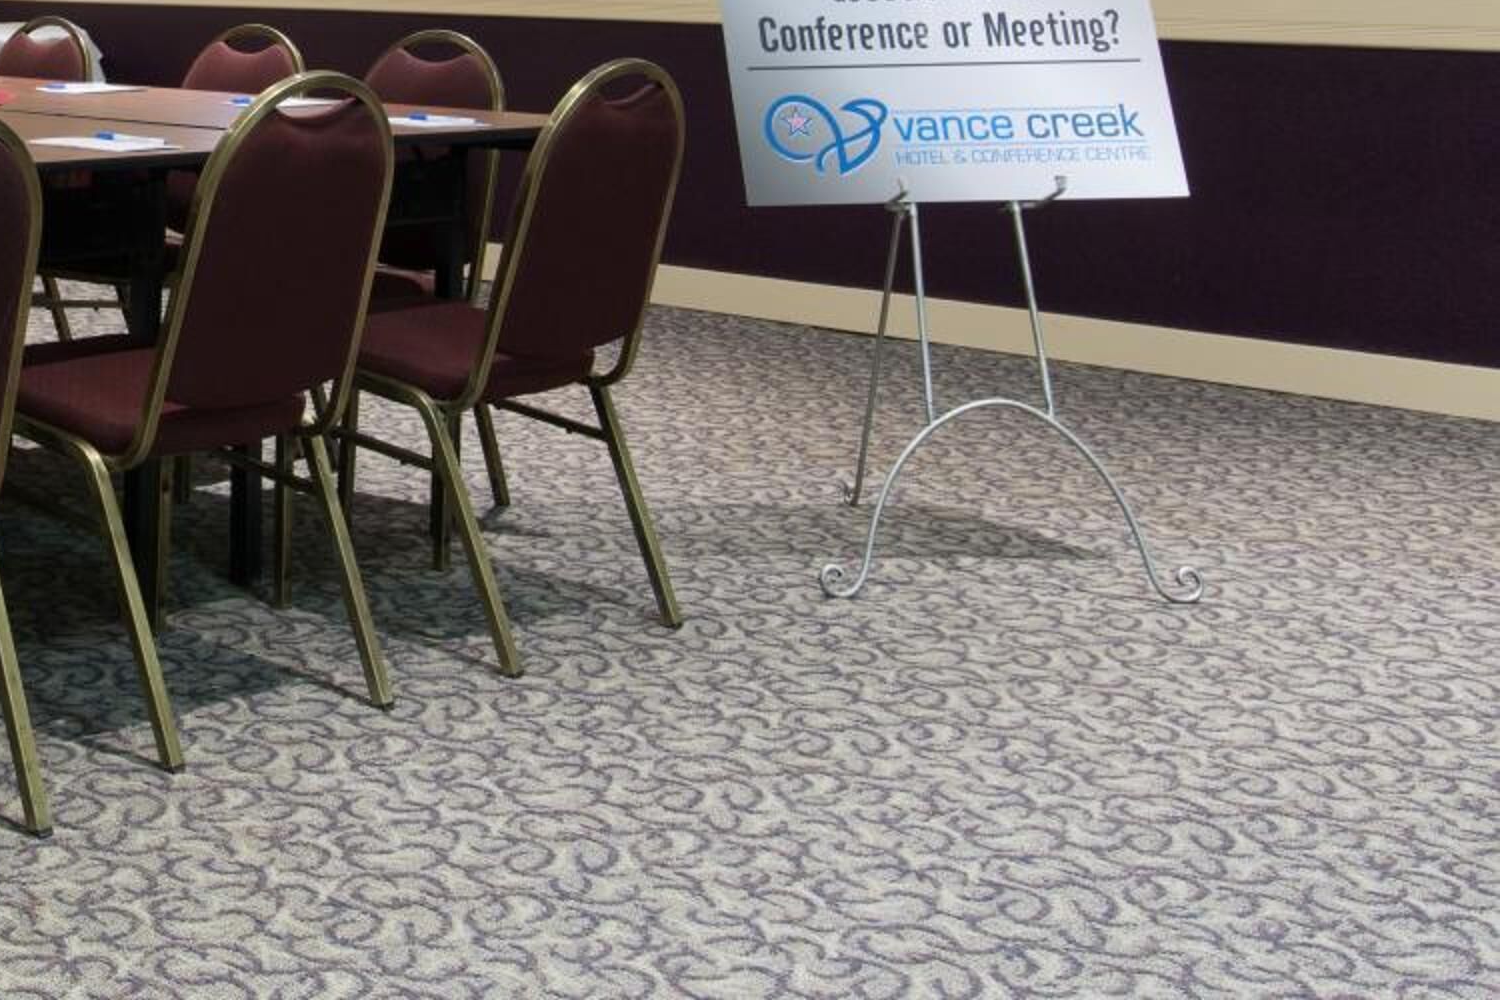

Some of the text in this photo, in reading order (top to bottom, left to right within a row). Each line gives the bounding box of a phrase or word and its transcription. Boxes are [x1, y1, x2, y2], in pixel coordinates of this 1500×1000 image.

[758, 9, 1120, 53] Conference or Meeting?
[893, 103, 1145, 142] vance creek
[895, 145, 1151, 166] HOTEL & CONFERENCE CENTRE
